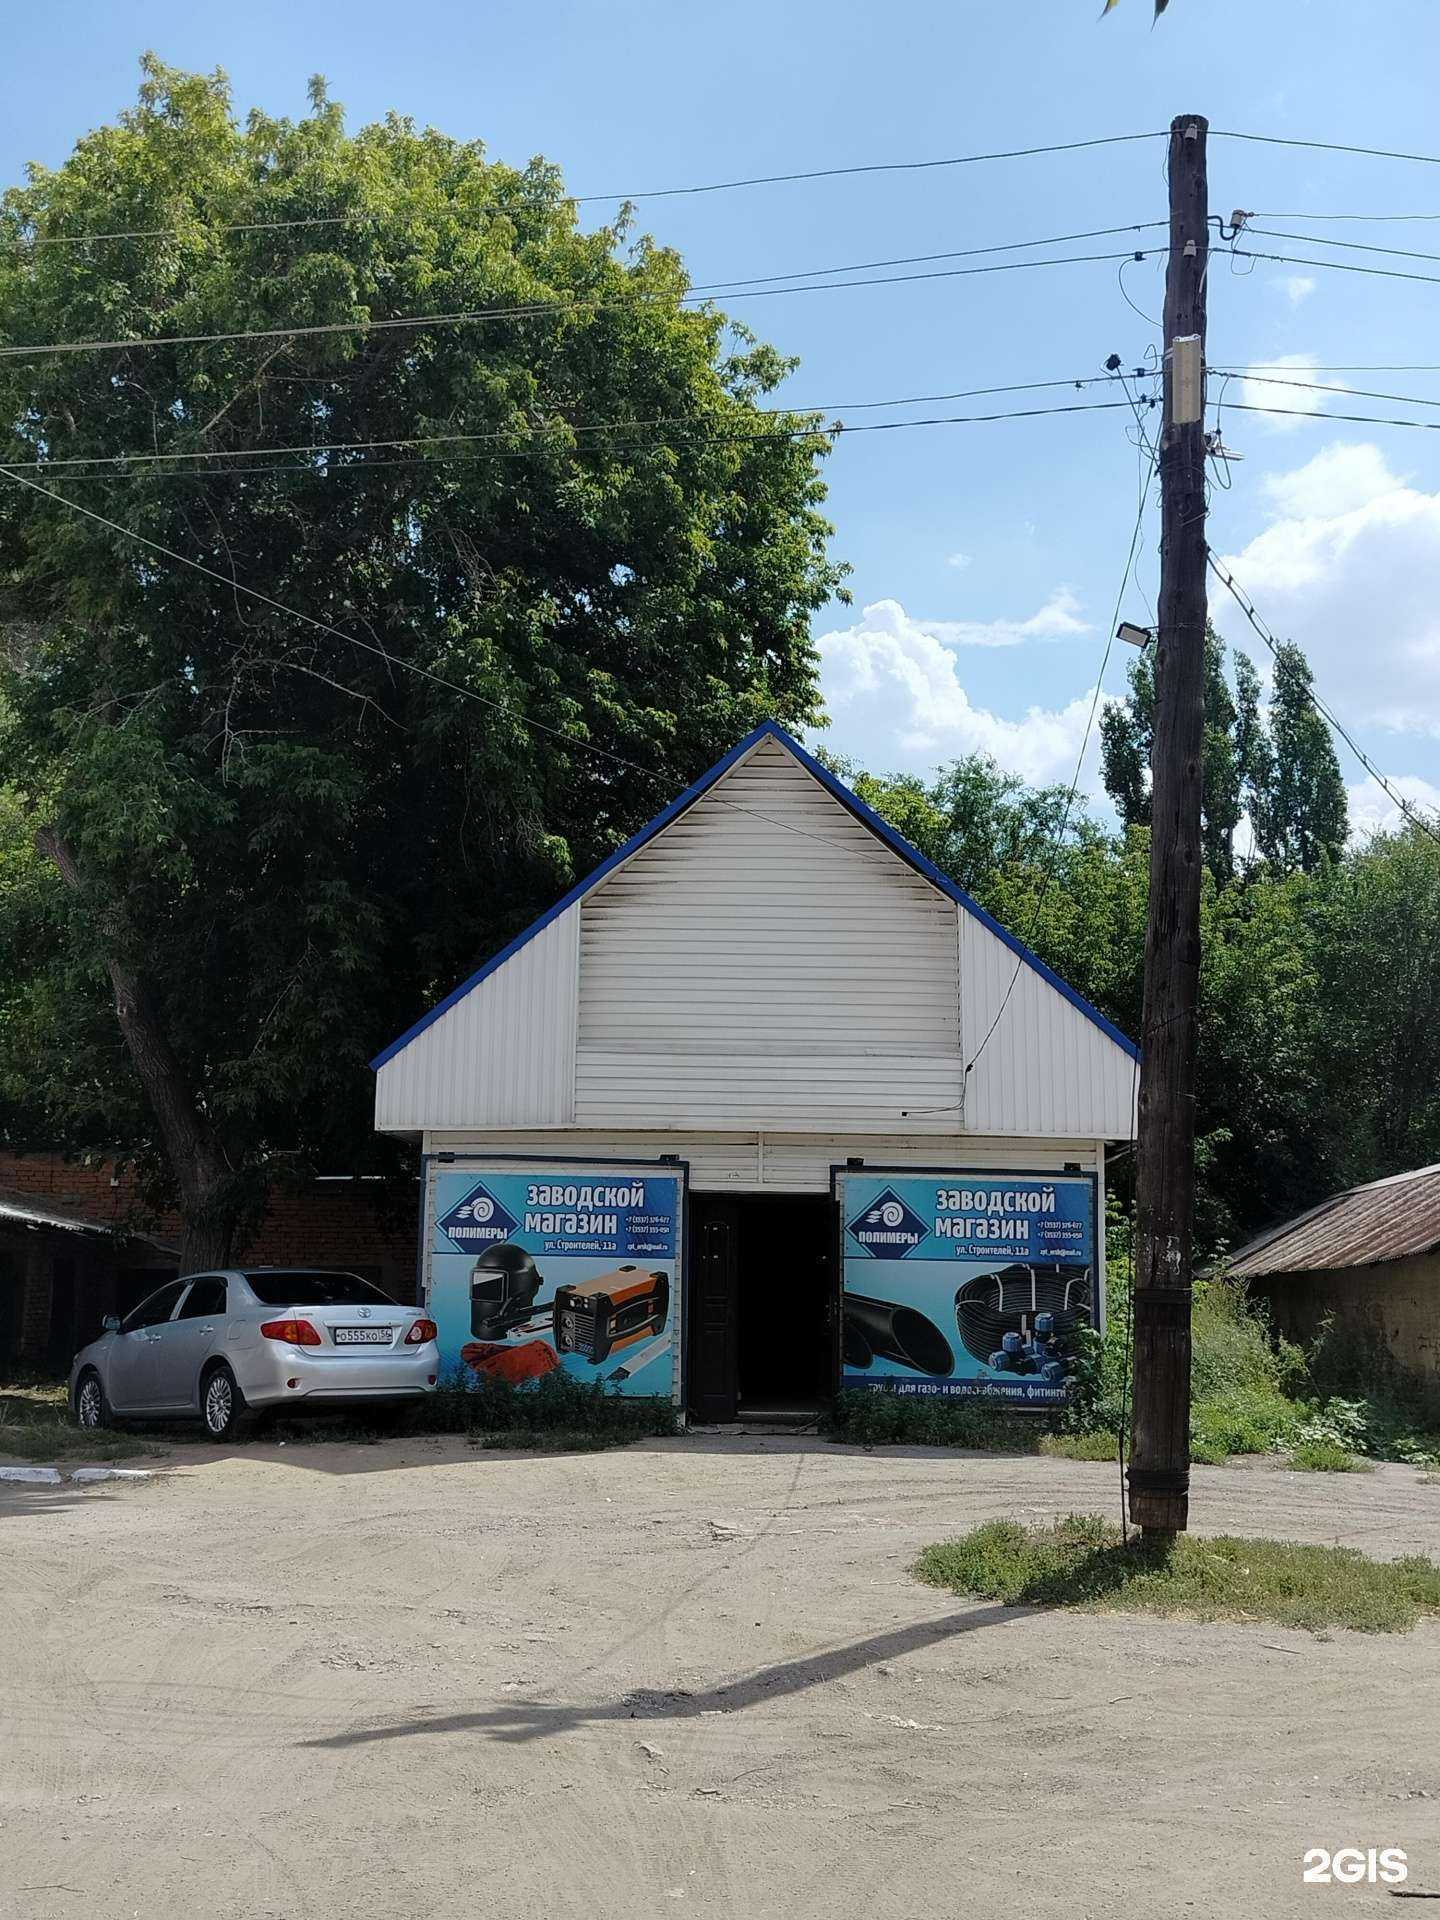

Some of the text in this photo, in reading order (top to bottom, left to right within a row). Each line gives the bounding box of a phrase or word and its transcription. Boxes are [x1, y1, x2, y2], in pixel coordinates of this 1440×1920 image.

[448, 1226, 508, 1240] ПОЛИМЕРЫ
[858, 1231, 919, 1244] ПОЛИМЕРЫ
[544, 1241, 556, 1251] ул.
[556, 1239, 602, 1251] Строителей,
[956, 1246, 967, 1256] ул.
[968, 1244, 1014, 1256] Строителей,
[898, 1383, 916, 1395] для
[917, 1384, 941, 1394] газо-
[942, 1385, 949, 1394] и
